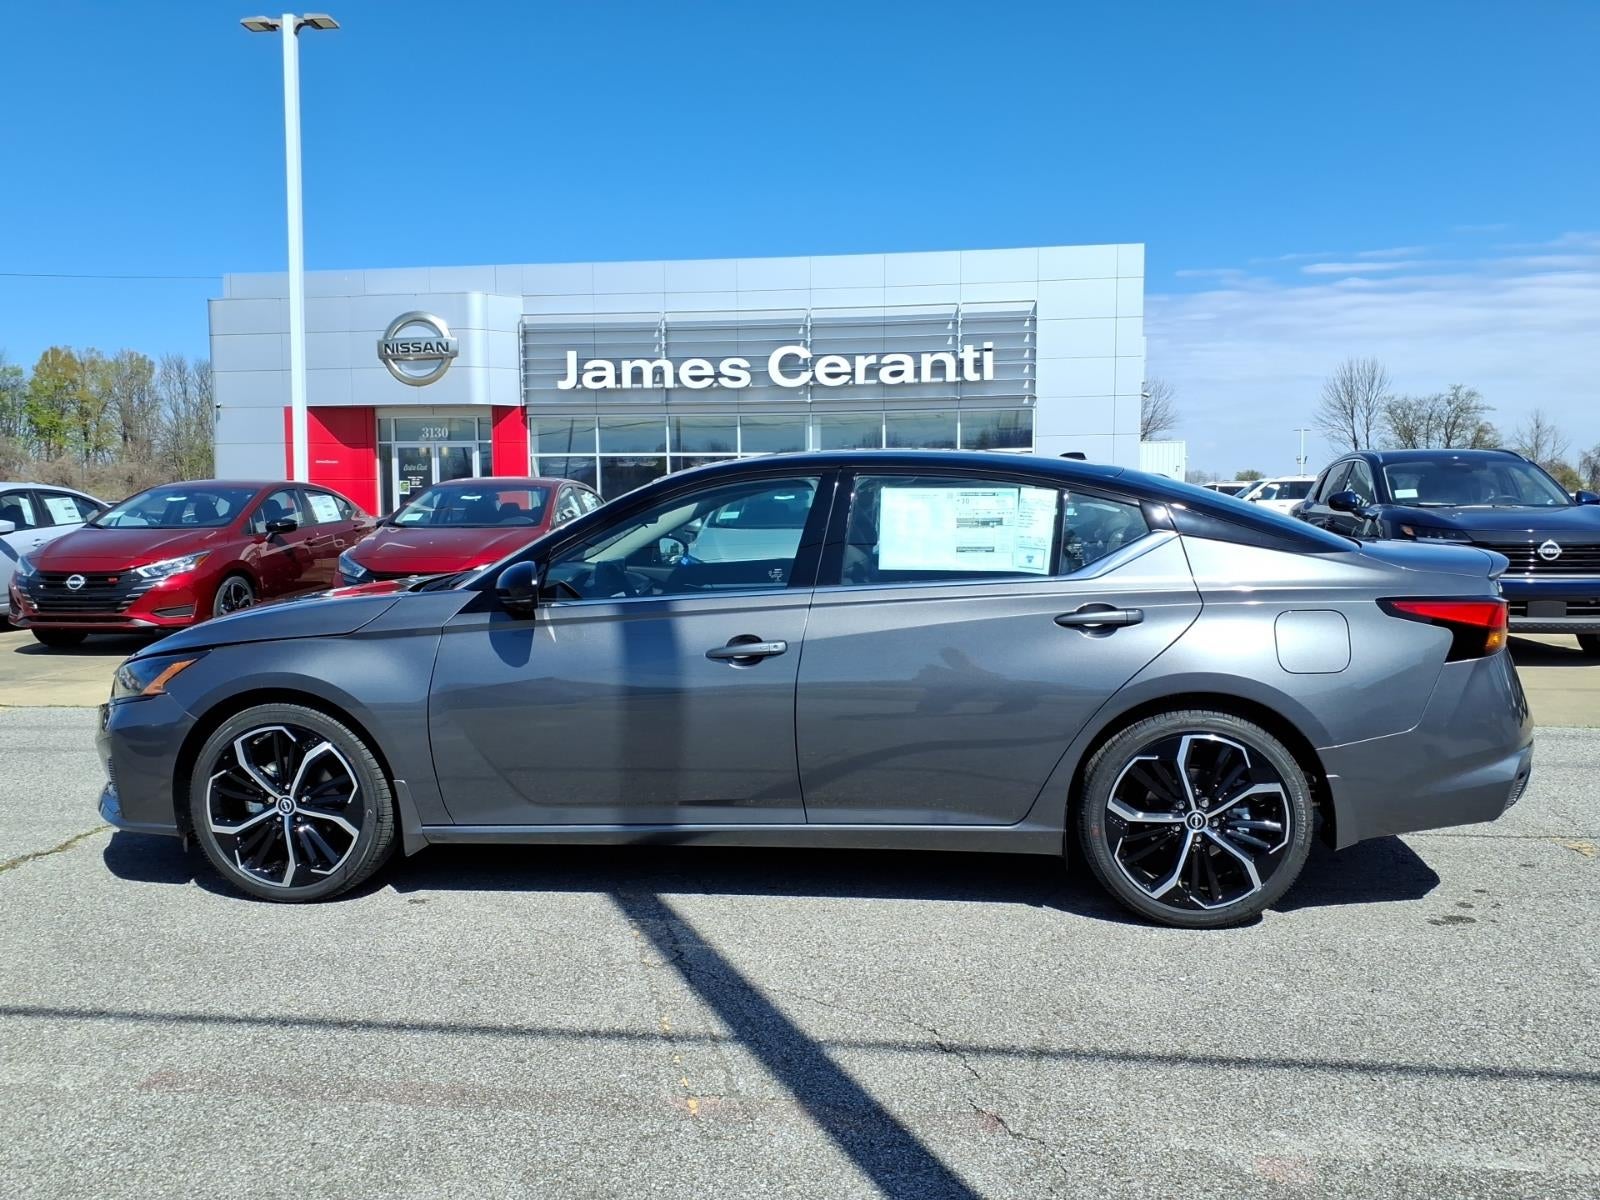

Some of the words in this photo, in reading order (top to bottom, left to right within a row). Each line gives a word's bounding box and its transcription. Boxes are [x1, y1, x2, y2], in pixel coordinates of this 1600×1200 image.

[384, 341, 449, 354] NISSAN
[557, 350, 752, 390] James
[767, 341, 994, 388] Ceranti
[422, 427, 448, 438] 3130
